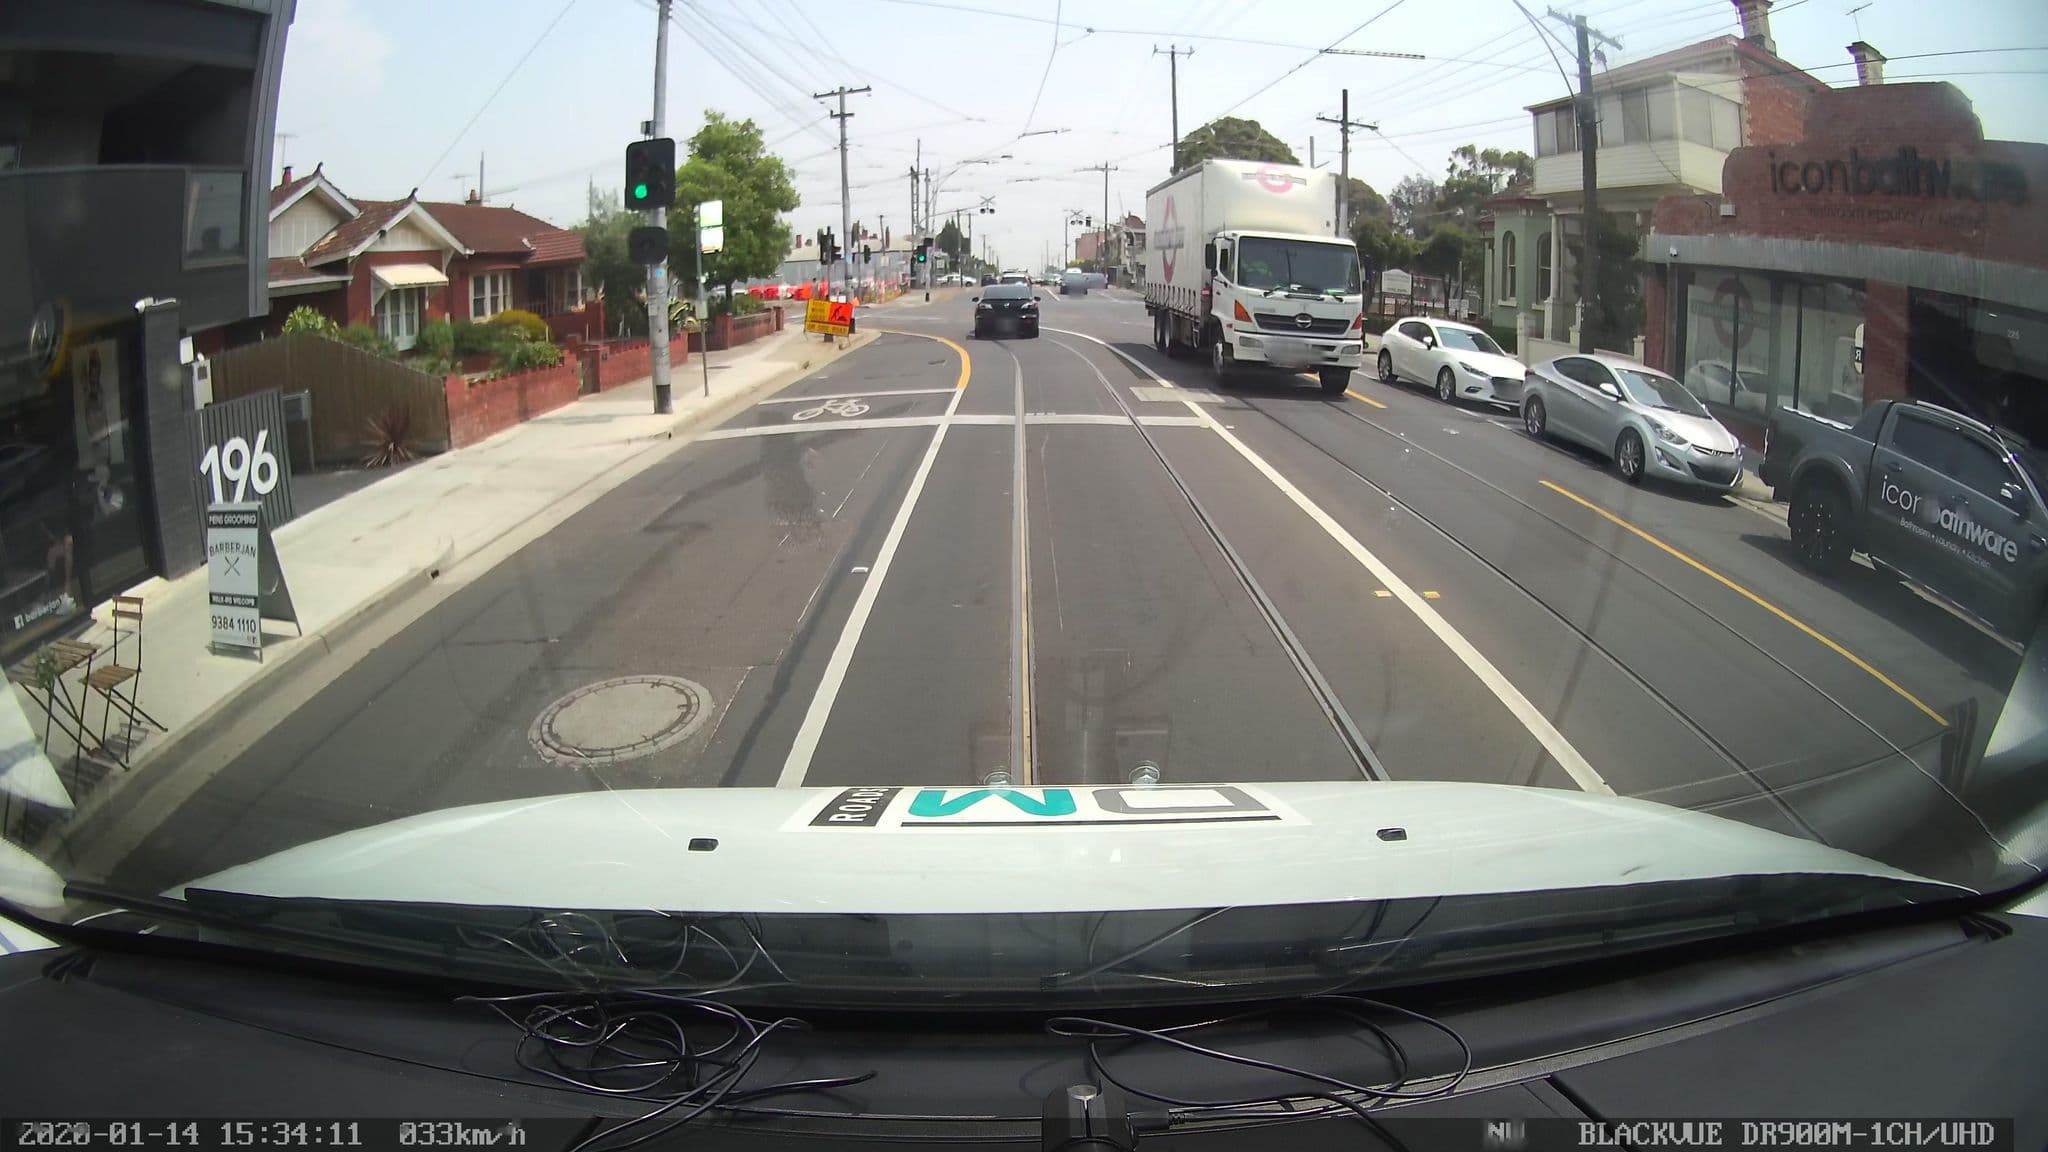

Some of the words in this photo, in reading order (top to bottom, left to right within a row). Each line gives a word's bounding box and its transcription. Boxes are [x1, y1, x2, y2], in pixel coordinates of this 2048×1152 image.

[200, 429, 279, 504] 196
[209, 541, 257, 558] BARBERJAN
[211, 615, 234, 630] 9384
[237, 617, 257, 633] 1110
[829, 788, 889, 821] ROADS
